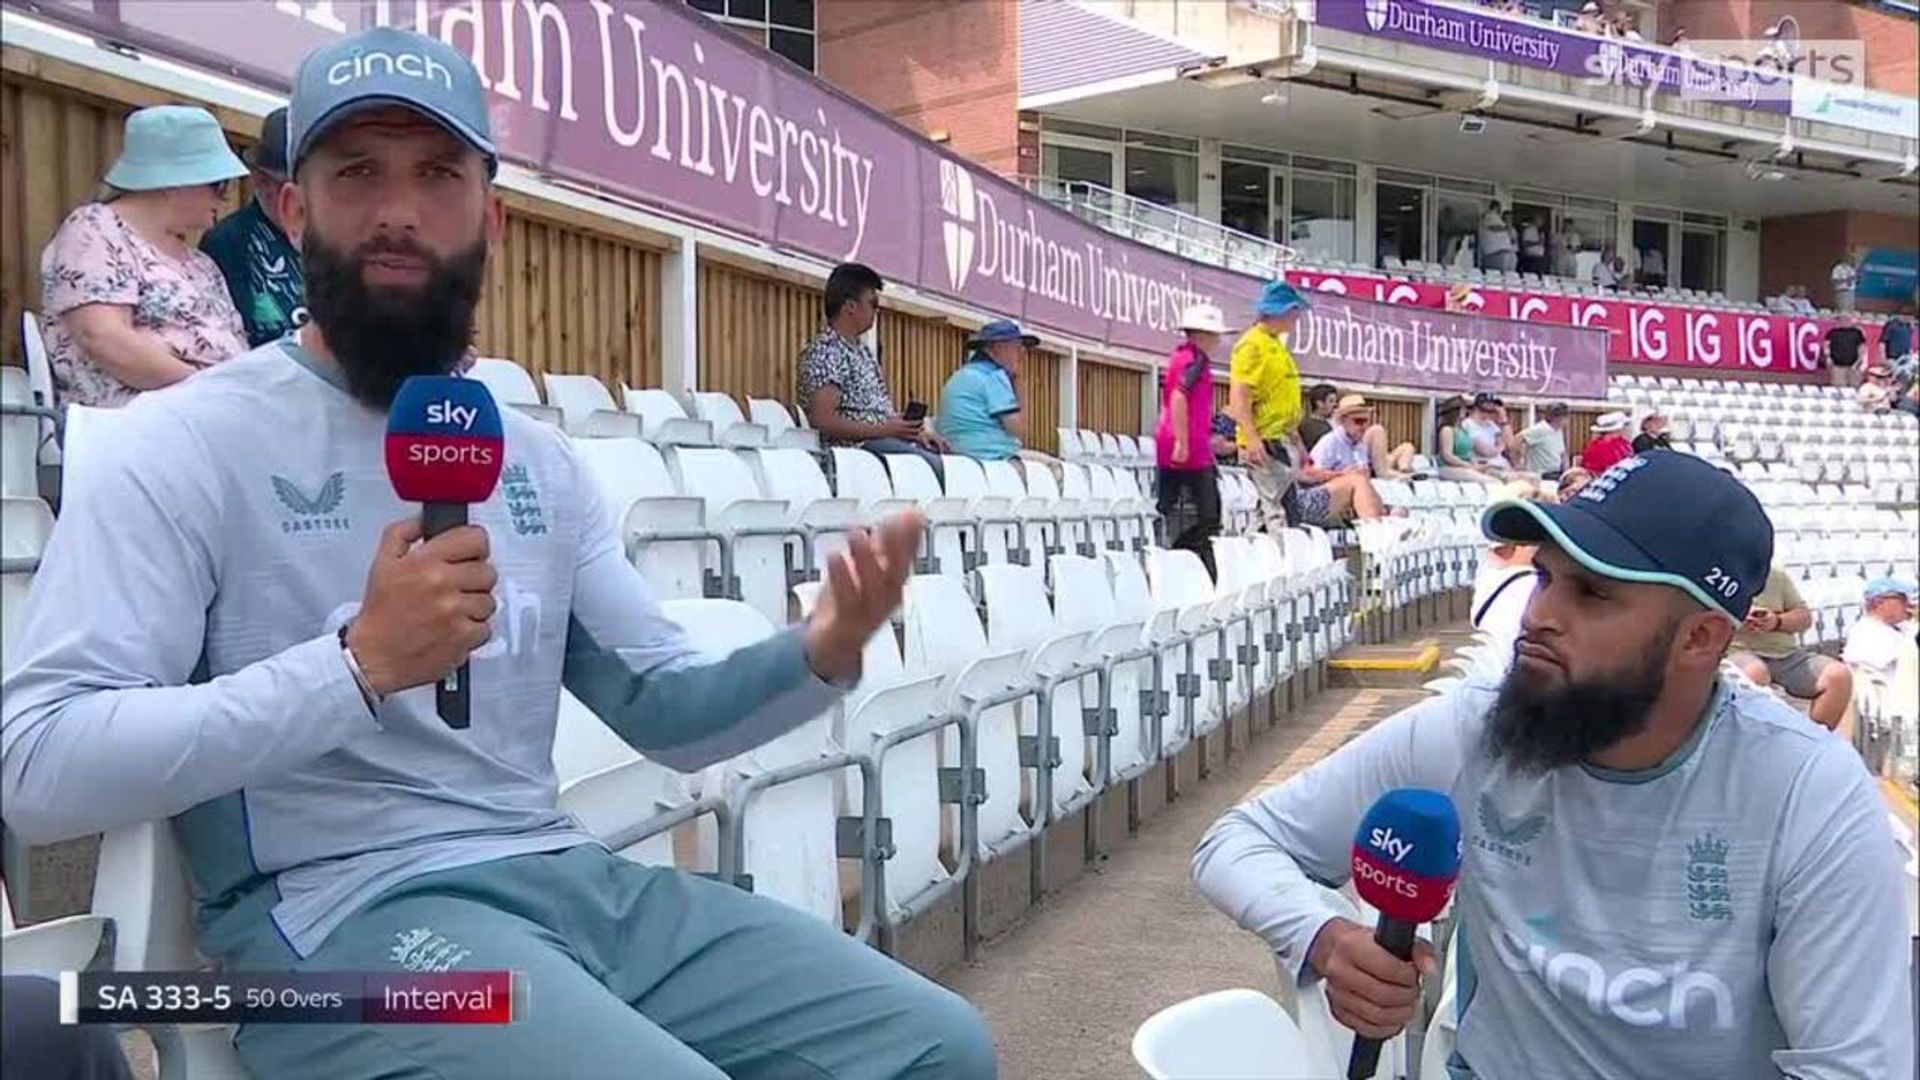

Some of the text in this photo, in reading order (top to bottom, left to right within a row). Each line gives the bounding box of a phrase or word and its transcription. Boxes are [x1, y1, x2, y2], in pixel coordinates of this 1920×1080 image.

[1389, 2, 1560, 69] Durham University
[328, 48, 453, 90] cinch
[598, 0, 874, 260] University
[976, 189, 1212, 338] Durham Universi
[1292, 305, 1557, 392] Durham University
[1629, 308, 1668, 361] IG
[1685, 313, 1721, 364] IG
[1738, 317, 1772, 368] IG
[1788, 322, 1820, 371] IG
[427, 400, 477, 431] sky
[409, 443, 493, 465] sports
[1704, 567, 1740, 598] 210
[1369, 827, 1414, 863] sky
[1353, 857, 1420, 899] sports
